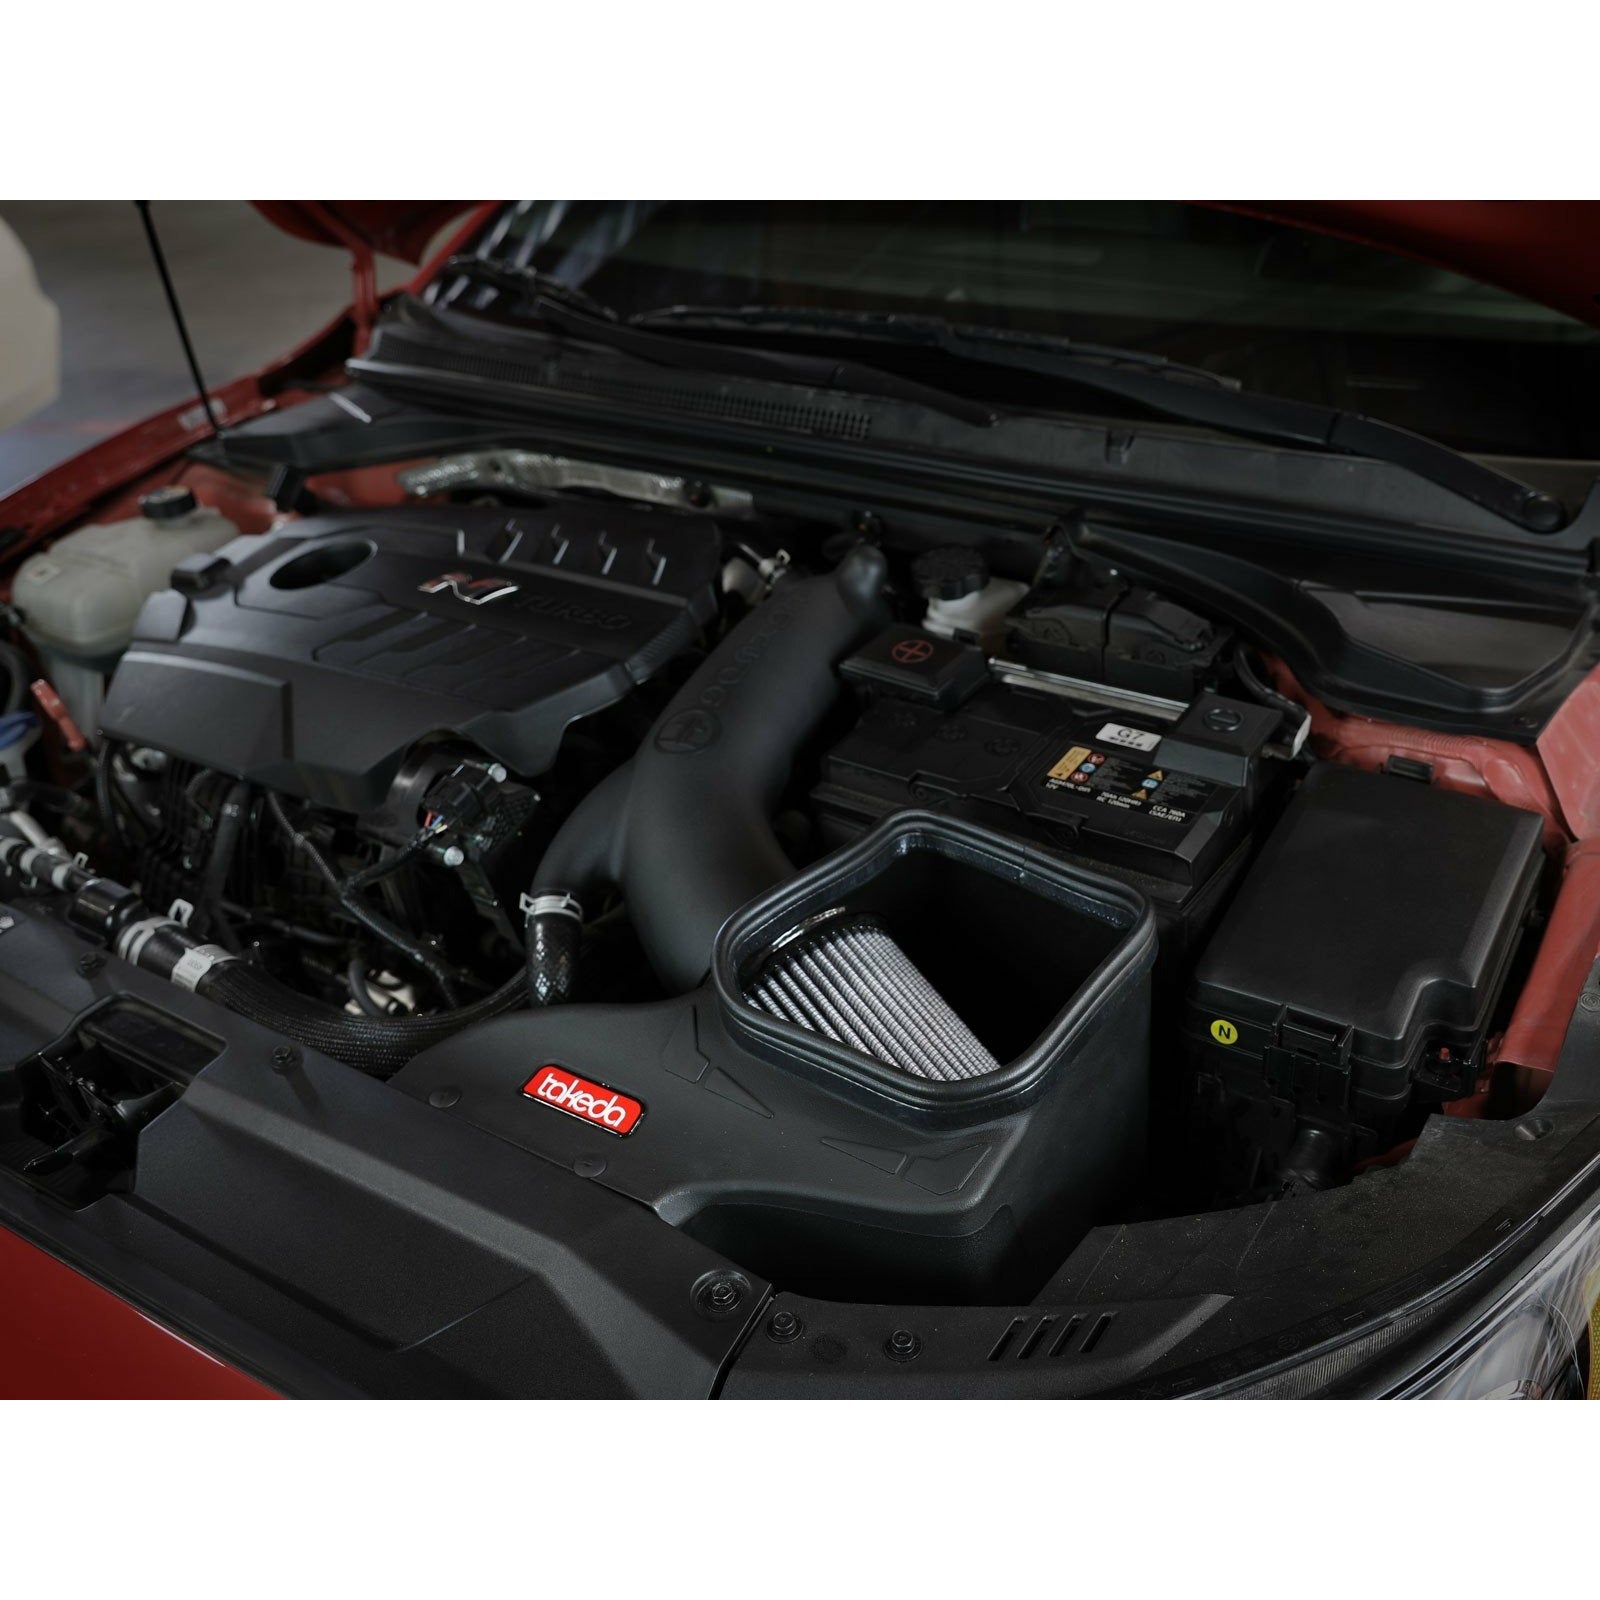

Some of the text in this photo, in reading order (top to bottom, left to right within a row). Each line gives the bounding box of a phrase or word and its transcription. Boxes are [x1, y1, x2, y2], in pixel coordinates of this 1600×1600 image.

[512, 592, 632, 630] TURBO
[1117, 728, 1144, 741] G7
[1152, 805, 1167, 813] CCA
[1218, 1024, 1231, 1040] N
[537, 1072, 626, 1127] takeda
